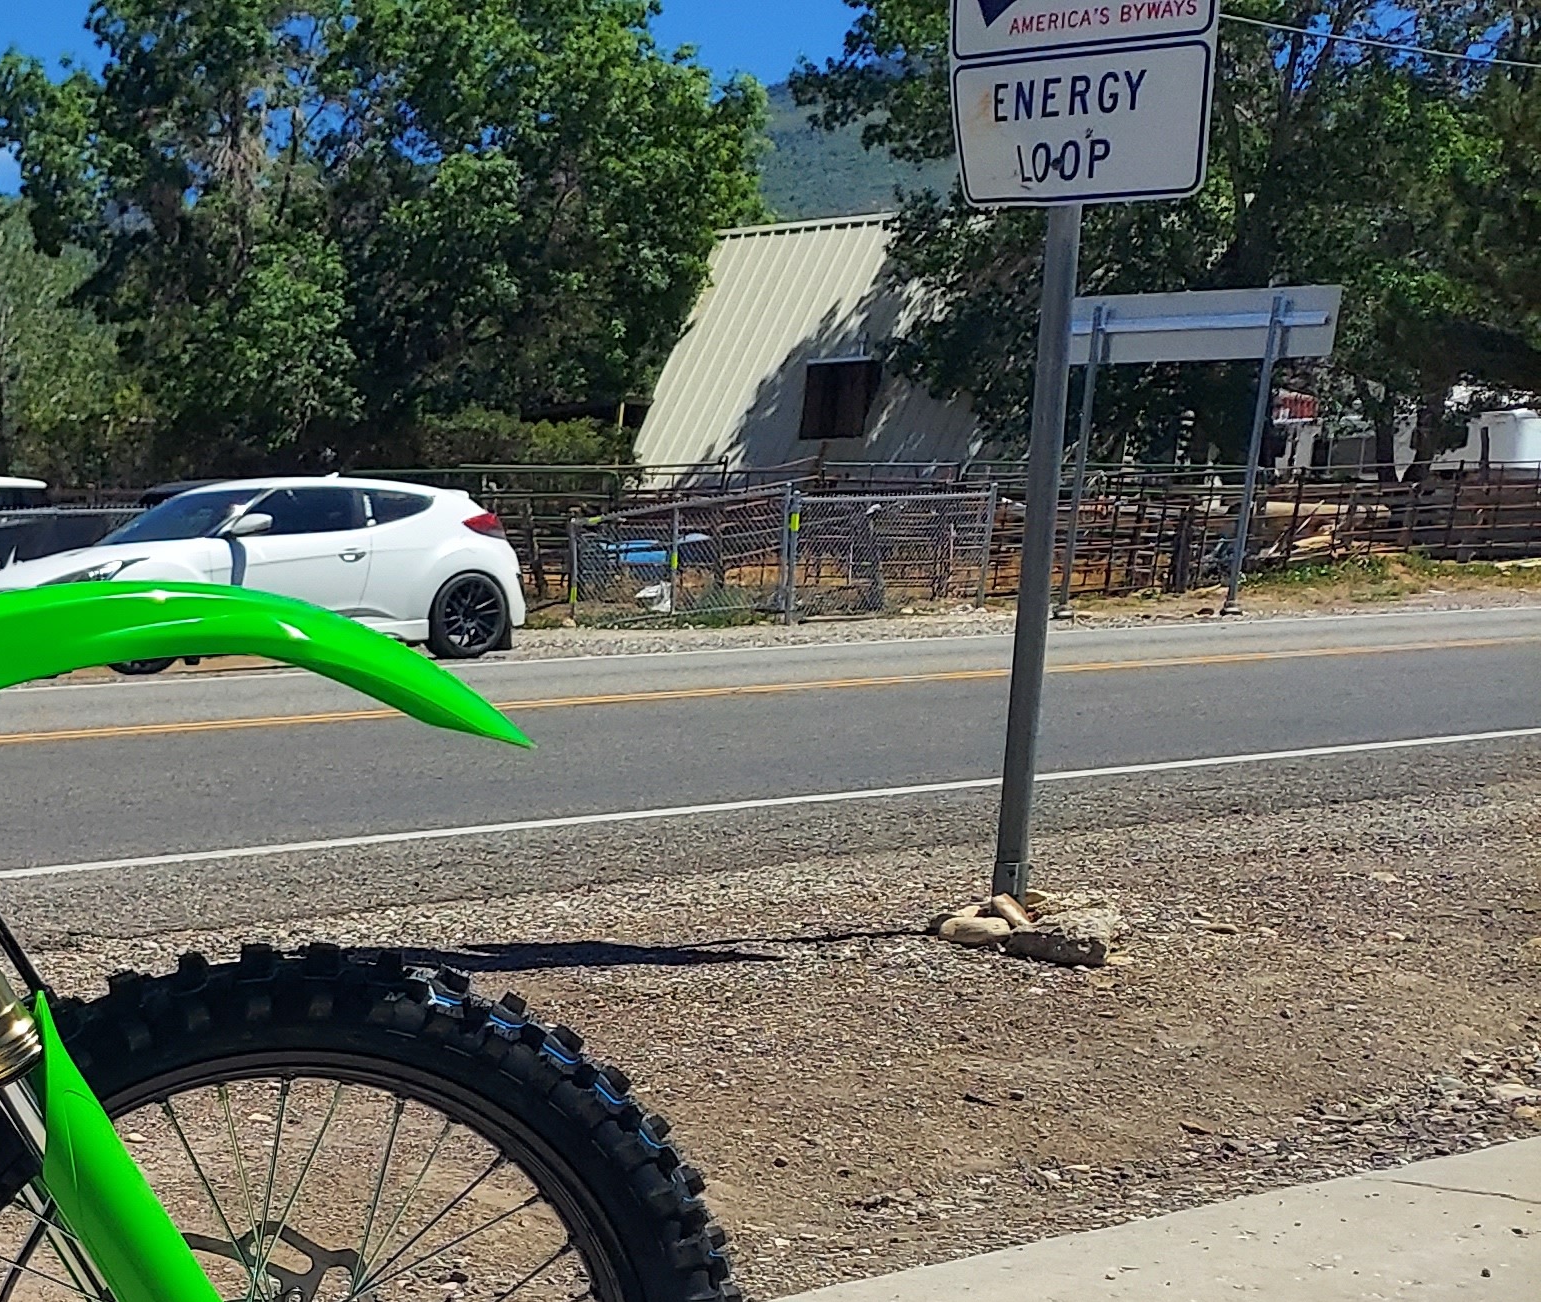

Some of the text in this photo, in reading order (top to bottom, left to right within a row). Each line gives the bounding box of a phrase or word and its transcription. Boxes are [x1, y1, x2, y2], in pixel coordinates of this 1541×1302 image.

[1009, 0, 1197, 36] AMERICA'S BYWAYS
[993, 69, 1148, 123] ENERGY
[1017, 138, 1112, 184] LOOP
